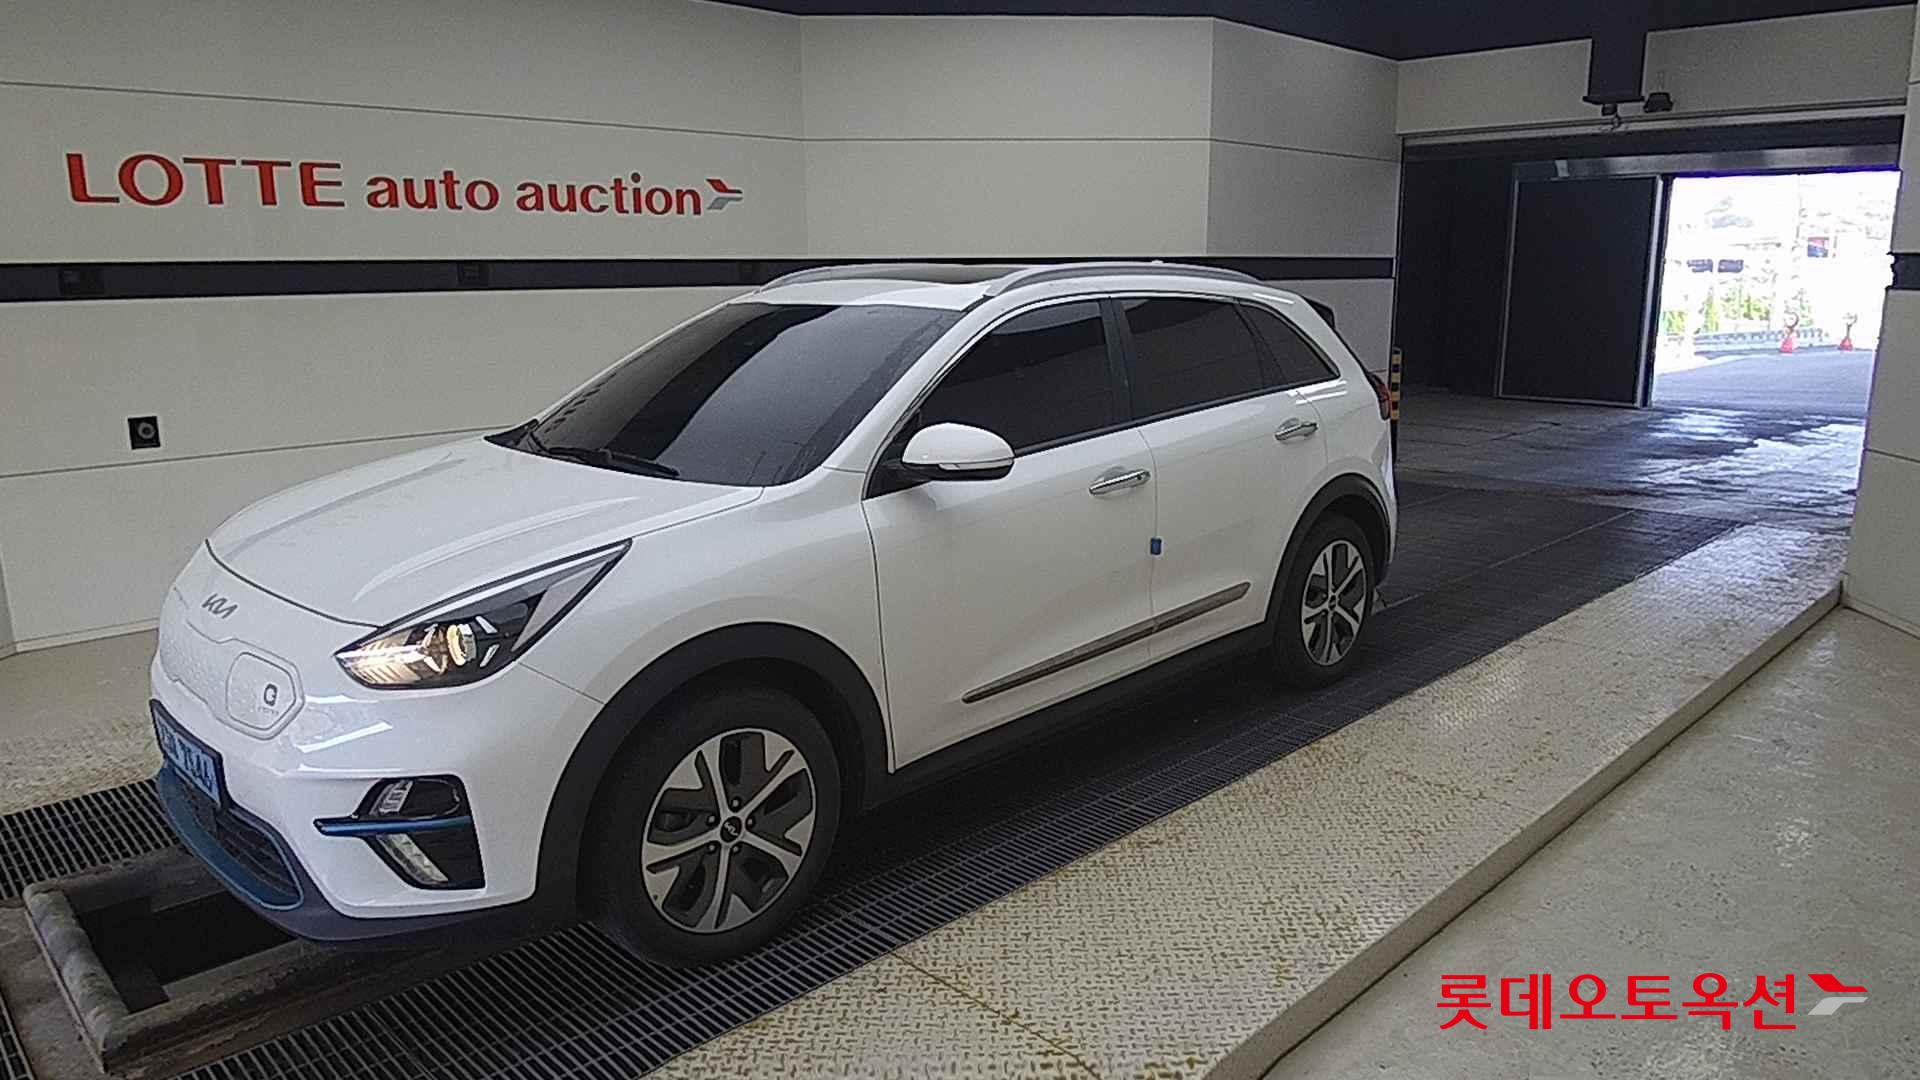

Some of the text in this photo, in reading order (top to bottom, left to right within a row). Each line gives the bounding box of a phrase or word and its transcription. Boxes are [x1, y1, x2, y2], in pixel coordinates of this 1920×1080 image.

[65, 152, 702, 216] LOTTE auto auction
